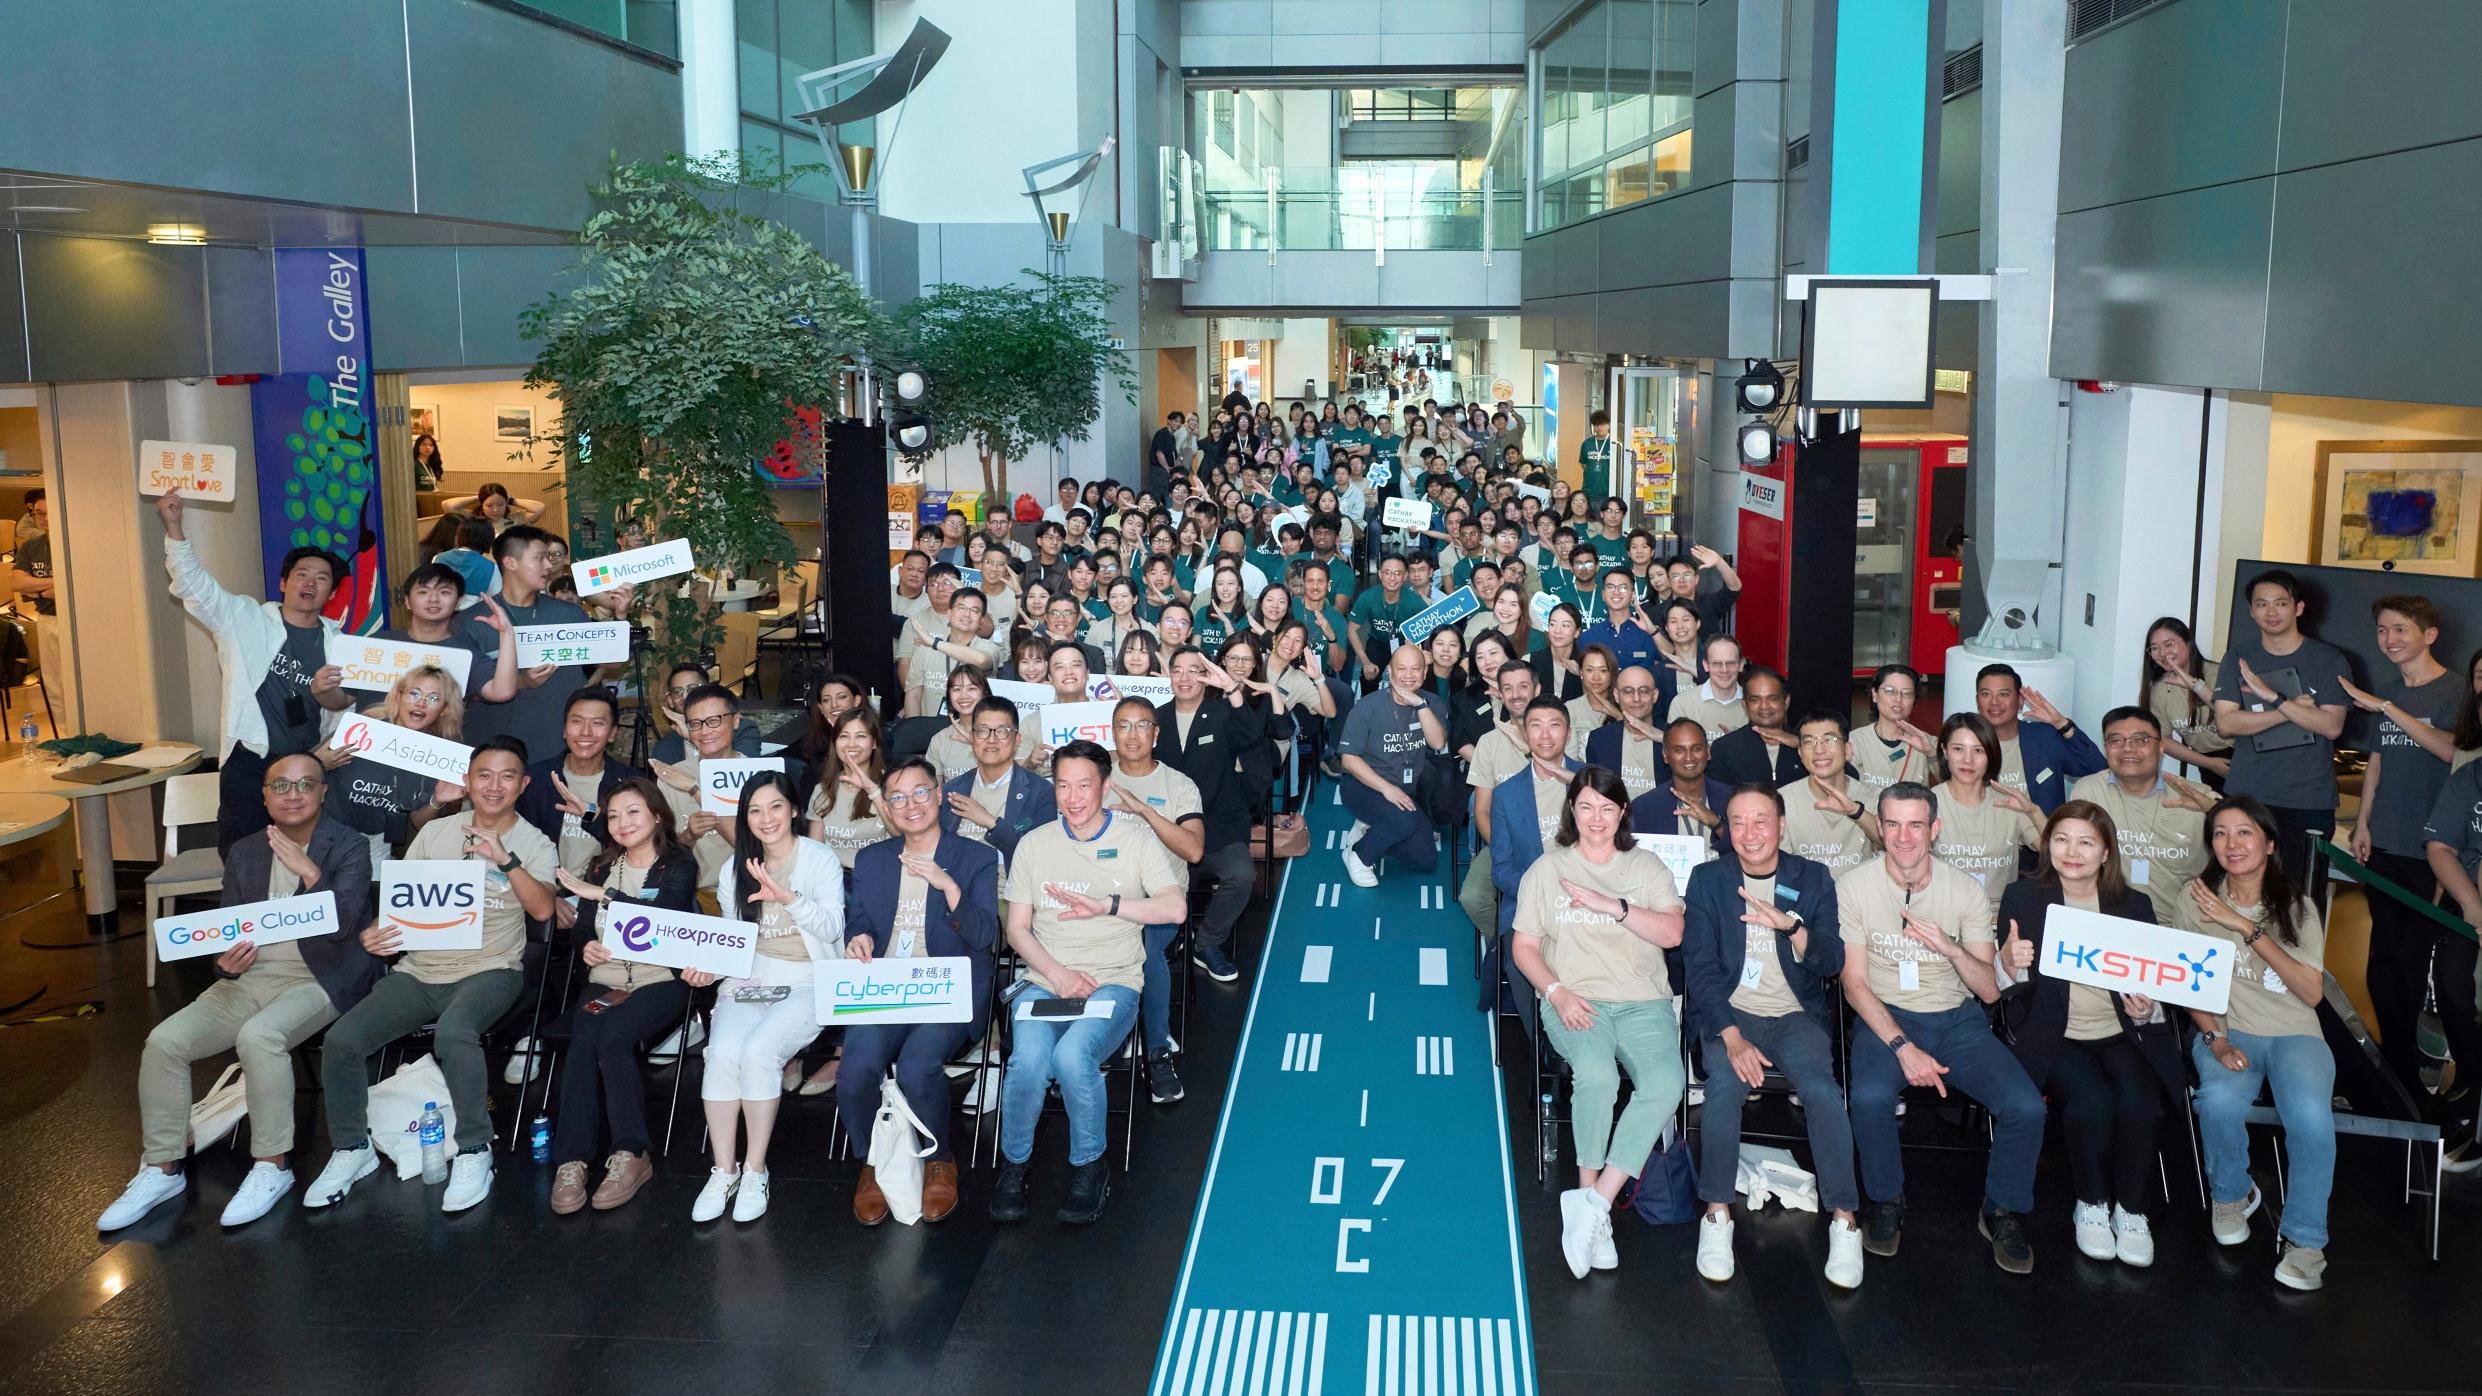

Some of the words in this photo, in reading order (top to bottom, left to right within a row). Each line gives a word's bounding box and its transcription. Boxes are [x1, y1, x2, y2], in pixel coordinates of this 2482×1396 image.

[323, 252, 358, 343] Galley
[1247, 343, 1259, 352] 25
[329, 355, 360, 408] The
[161, 450, 215, 473] 智會愛
[1388, 508, 1413, 517] CATHAY
[1387, 516, 1427, 527] HACKATHON
[613, 553, 676, 579] Microsoft
[1408, 609, 1440, 632] CATHAY
[1411, 605, 1464, 640] HACKATHON
[517, 632, 554, 643] TEAM
[557, 629, 617, 641] CONCEPTS
[541, 646, 590, 663] 天空社
[1052, 723, 1113, 745] HKST
[382, 738, 468, 775] Asiabots
[1621, 766, 1645, 777] THAY
[2000, 772, 2020, 784] HAY
[712, 771, 755, 790] aw
[824, 826, 857, 838] ATHAY
[2116, 830, 2154, 843] ATHAY
[825, 836, 889, 850] ACKATHON
[1800, 844, 1843, 855] CATHAY
[1938, 843, 1987, 856] CATHAY
[2118, 843, 2189, 860] ACKATHON
[391, 882, 475, 908] aws
[1040, 880, 1091, 895] CTHAY
[168, 917, 255, 945] Google
[260, 905, 325, 930] Cloud
[1555, 911, 1617, 926] HACKATH
[655, 923, 747, 949] HKexpress
[911, 966, 951, 979] 數碼港
[2056, 941, 2187, 987] HKSTP
[836, 975, 955, 1005] Cyberport
[1335, 1218, 1372, 1274] C
